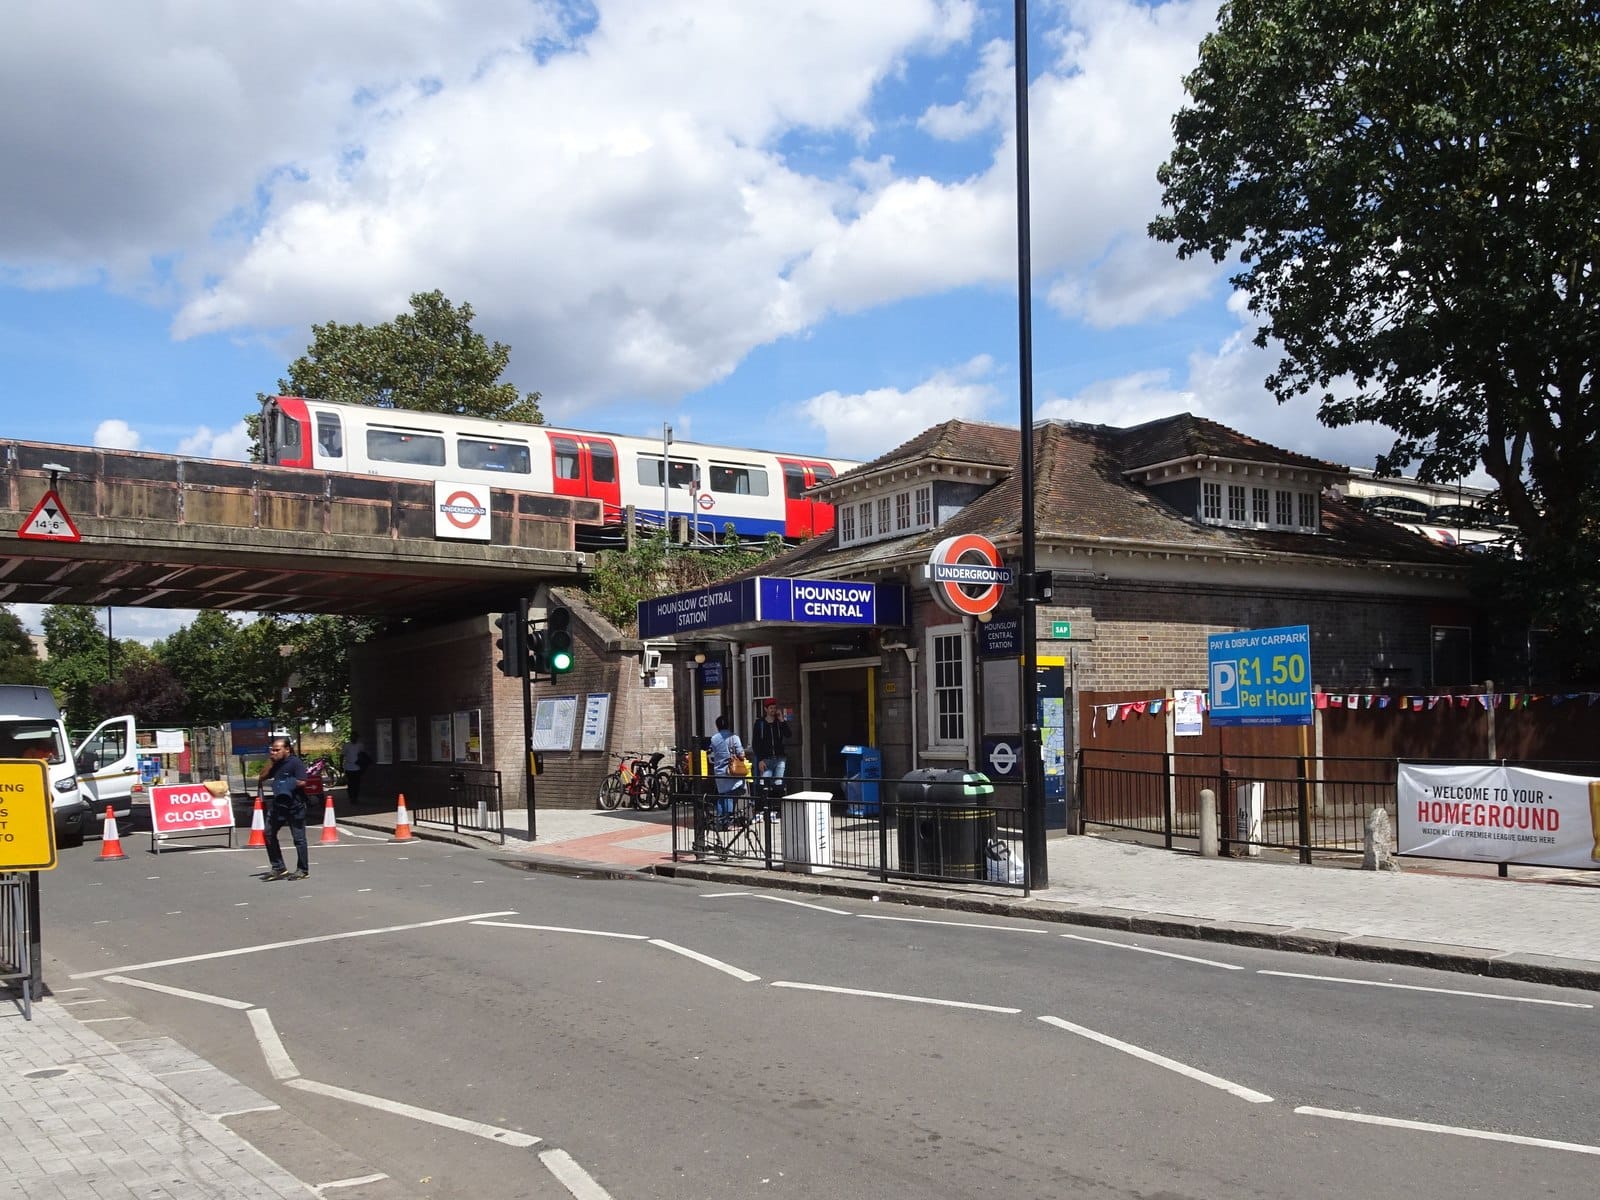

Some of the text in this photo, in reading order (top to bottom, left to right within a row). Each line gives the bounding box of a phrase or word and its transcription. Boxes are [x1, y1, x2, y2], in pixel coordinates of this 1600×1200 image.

[938, 567, 1010, 580] UNDERGROUND
[795, 586, 871, 603] HOUNSLOW
[657, 591, 732, 616] HOUNSLOW CENTRAL
[804, 602, 863, 617] CENTRAL
[678, 610, 707, 626] STATION
[984, 621, 1017, 631] HOUNSLOW
[988, 631, 1014, 641] CENTRAL
[1210, 633, 1306, 650] PAY & DISPLAY CARPARK
[989, 641, 1013, 650] STATION
[1239, 654, 1305, 685] £1.50
[1241, 689, 1308, 707] Per Hour
[169, 792, 212, 804] ROAD
[1432, 786, 1543, 804] WELCOME TO YOUR
[164, 809, 222, 823] CLOSED
[1417, 801, 1560, 831] HOMEGROUND
[1422, 828, 1441, 836] WATCH
[1465, 831, 1492, 840] PREMIER
[1493, 833, 1516, 842] LEAGUE
[1517, 834, 1538, 843] GAMES
[1538, 836, 1556, 844] HERE
